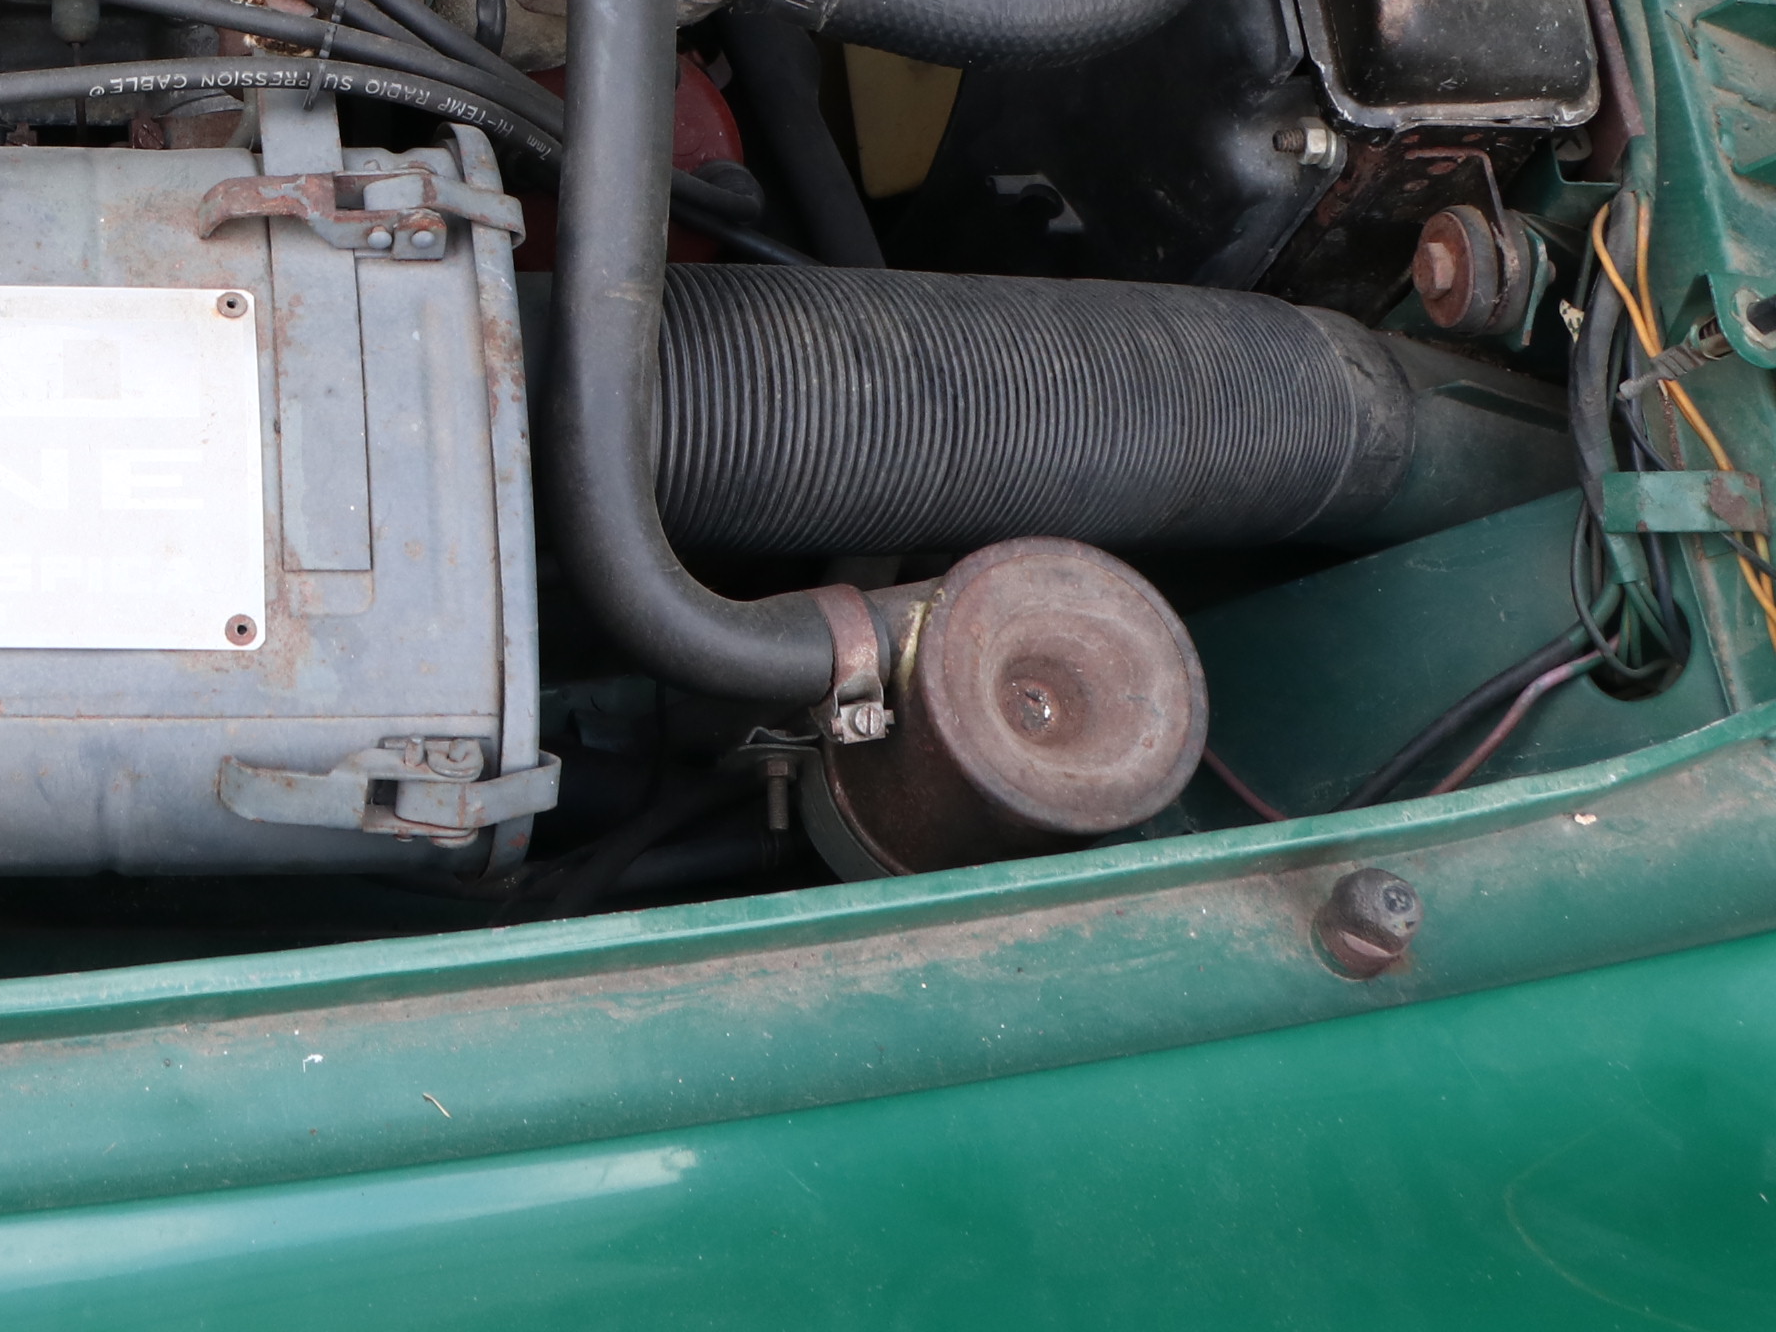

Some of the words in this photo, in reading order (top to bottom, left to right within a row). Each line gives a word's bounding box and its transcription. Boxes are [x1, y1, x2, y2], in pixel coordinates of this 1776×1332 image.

[199, 70, 354, 93] SUPRESSION
[364, 79, 430, 109] RADIO
[436, 99, 515, 137] HI-TEMP
[524, 133, 553, 162] 7mm
